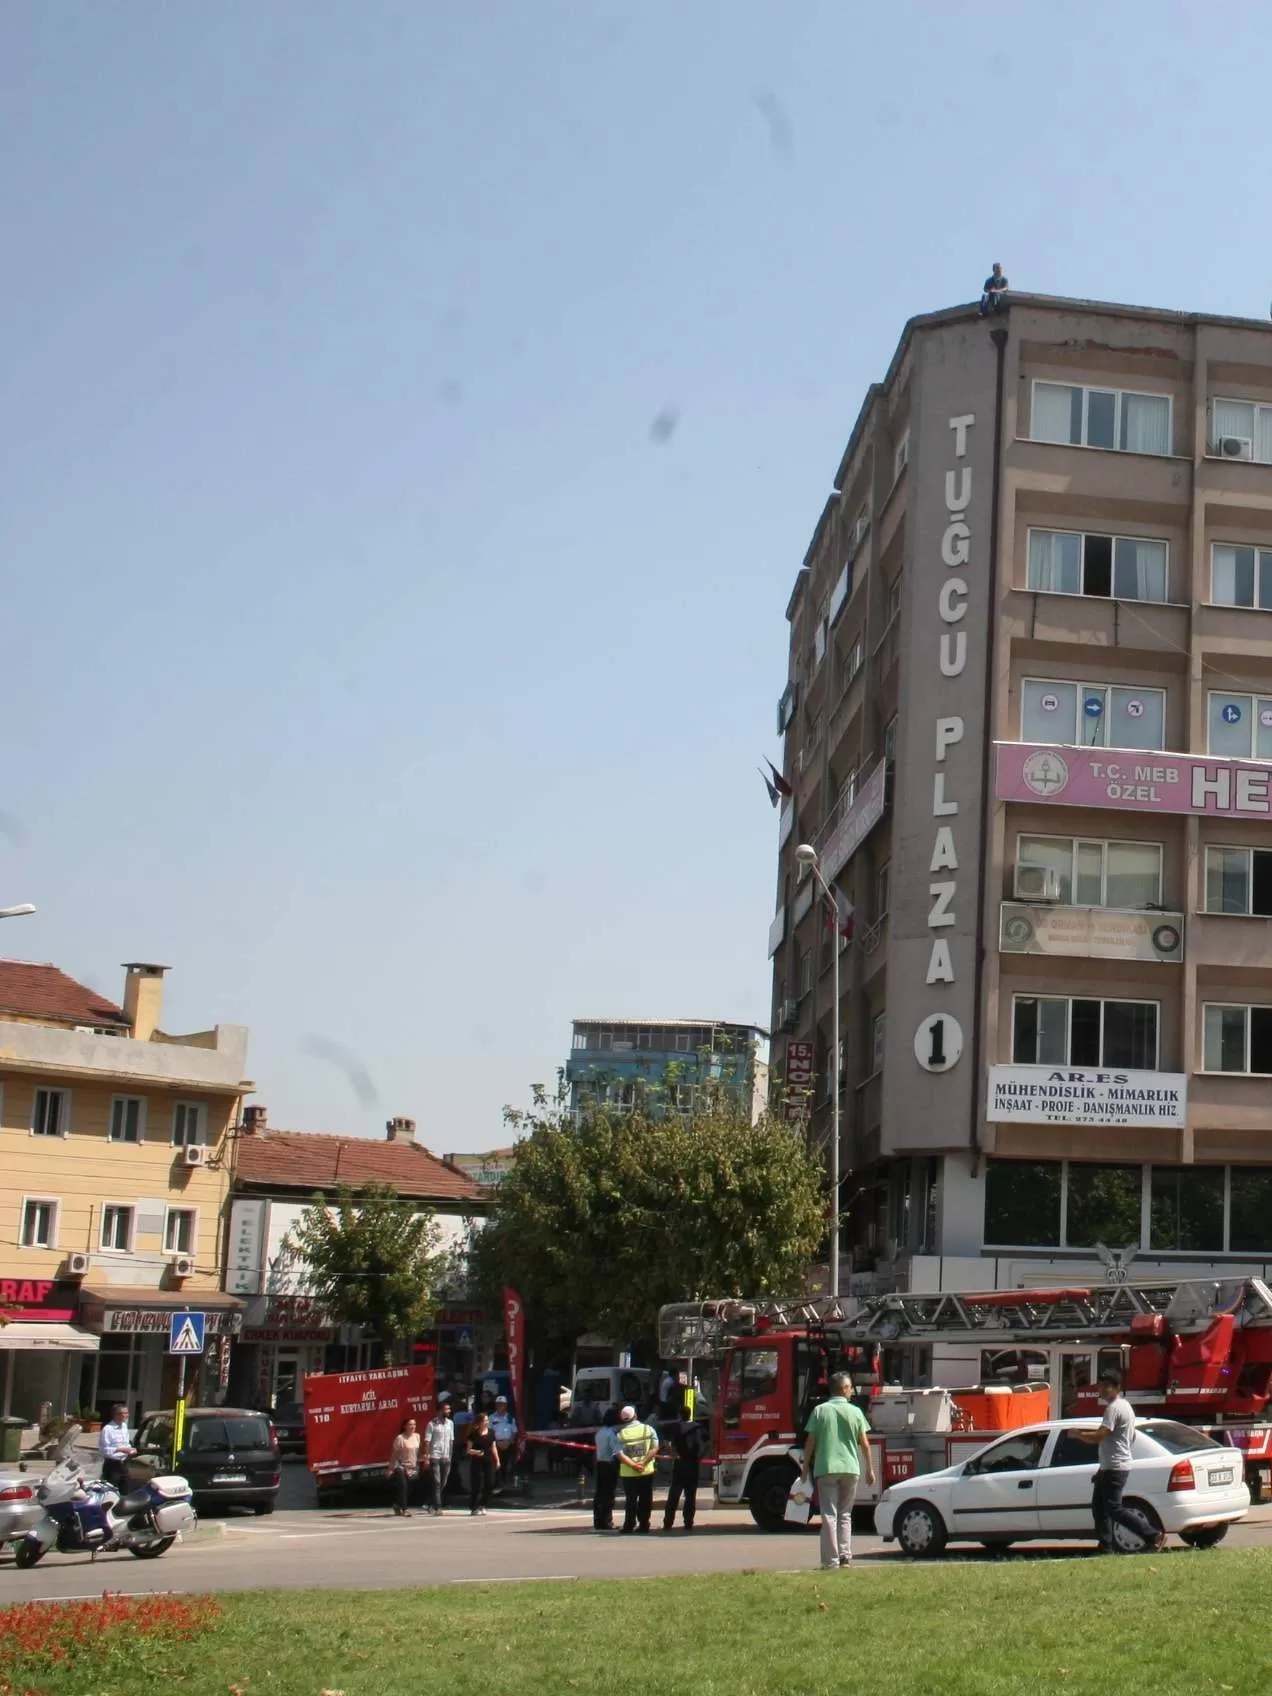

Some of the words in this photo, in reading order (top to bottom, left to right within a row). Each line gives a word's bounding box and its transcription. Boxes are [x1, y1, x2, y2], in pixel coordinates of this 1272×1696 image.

[939, 414, 975, 677] TUĞCU
[1089, 762, 1127, 780] T.C.
[1135, 768, 1179, 783] MEB
[1106, 783, 1161, 801] ÖZEL
[926, 716, 964, 985] PLAZA
[789, 1044, 811, 1057] 15.
[928, 1019, 946, 1065] 1
[995, 1081, 1095, 1099] MÜHENDİSLİK
[1108, 1086, 1179, 1102] MİMARLIK
[994, 1098, 1032, 1113] İNŞAAT
[1041, 1101, 1074, 1113] PROJE
[1083, 1103, 1156, 1118] DANIŞMANLIK
[378, 1399, 398, 1410] ARACI
[413, 1403, 428, 1411] 110
[314, 1415, 330, 1423] 110
[892, 1465, 907, 1475] 110
